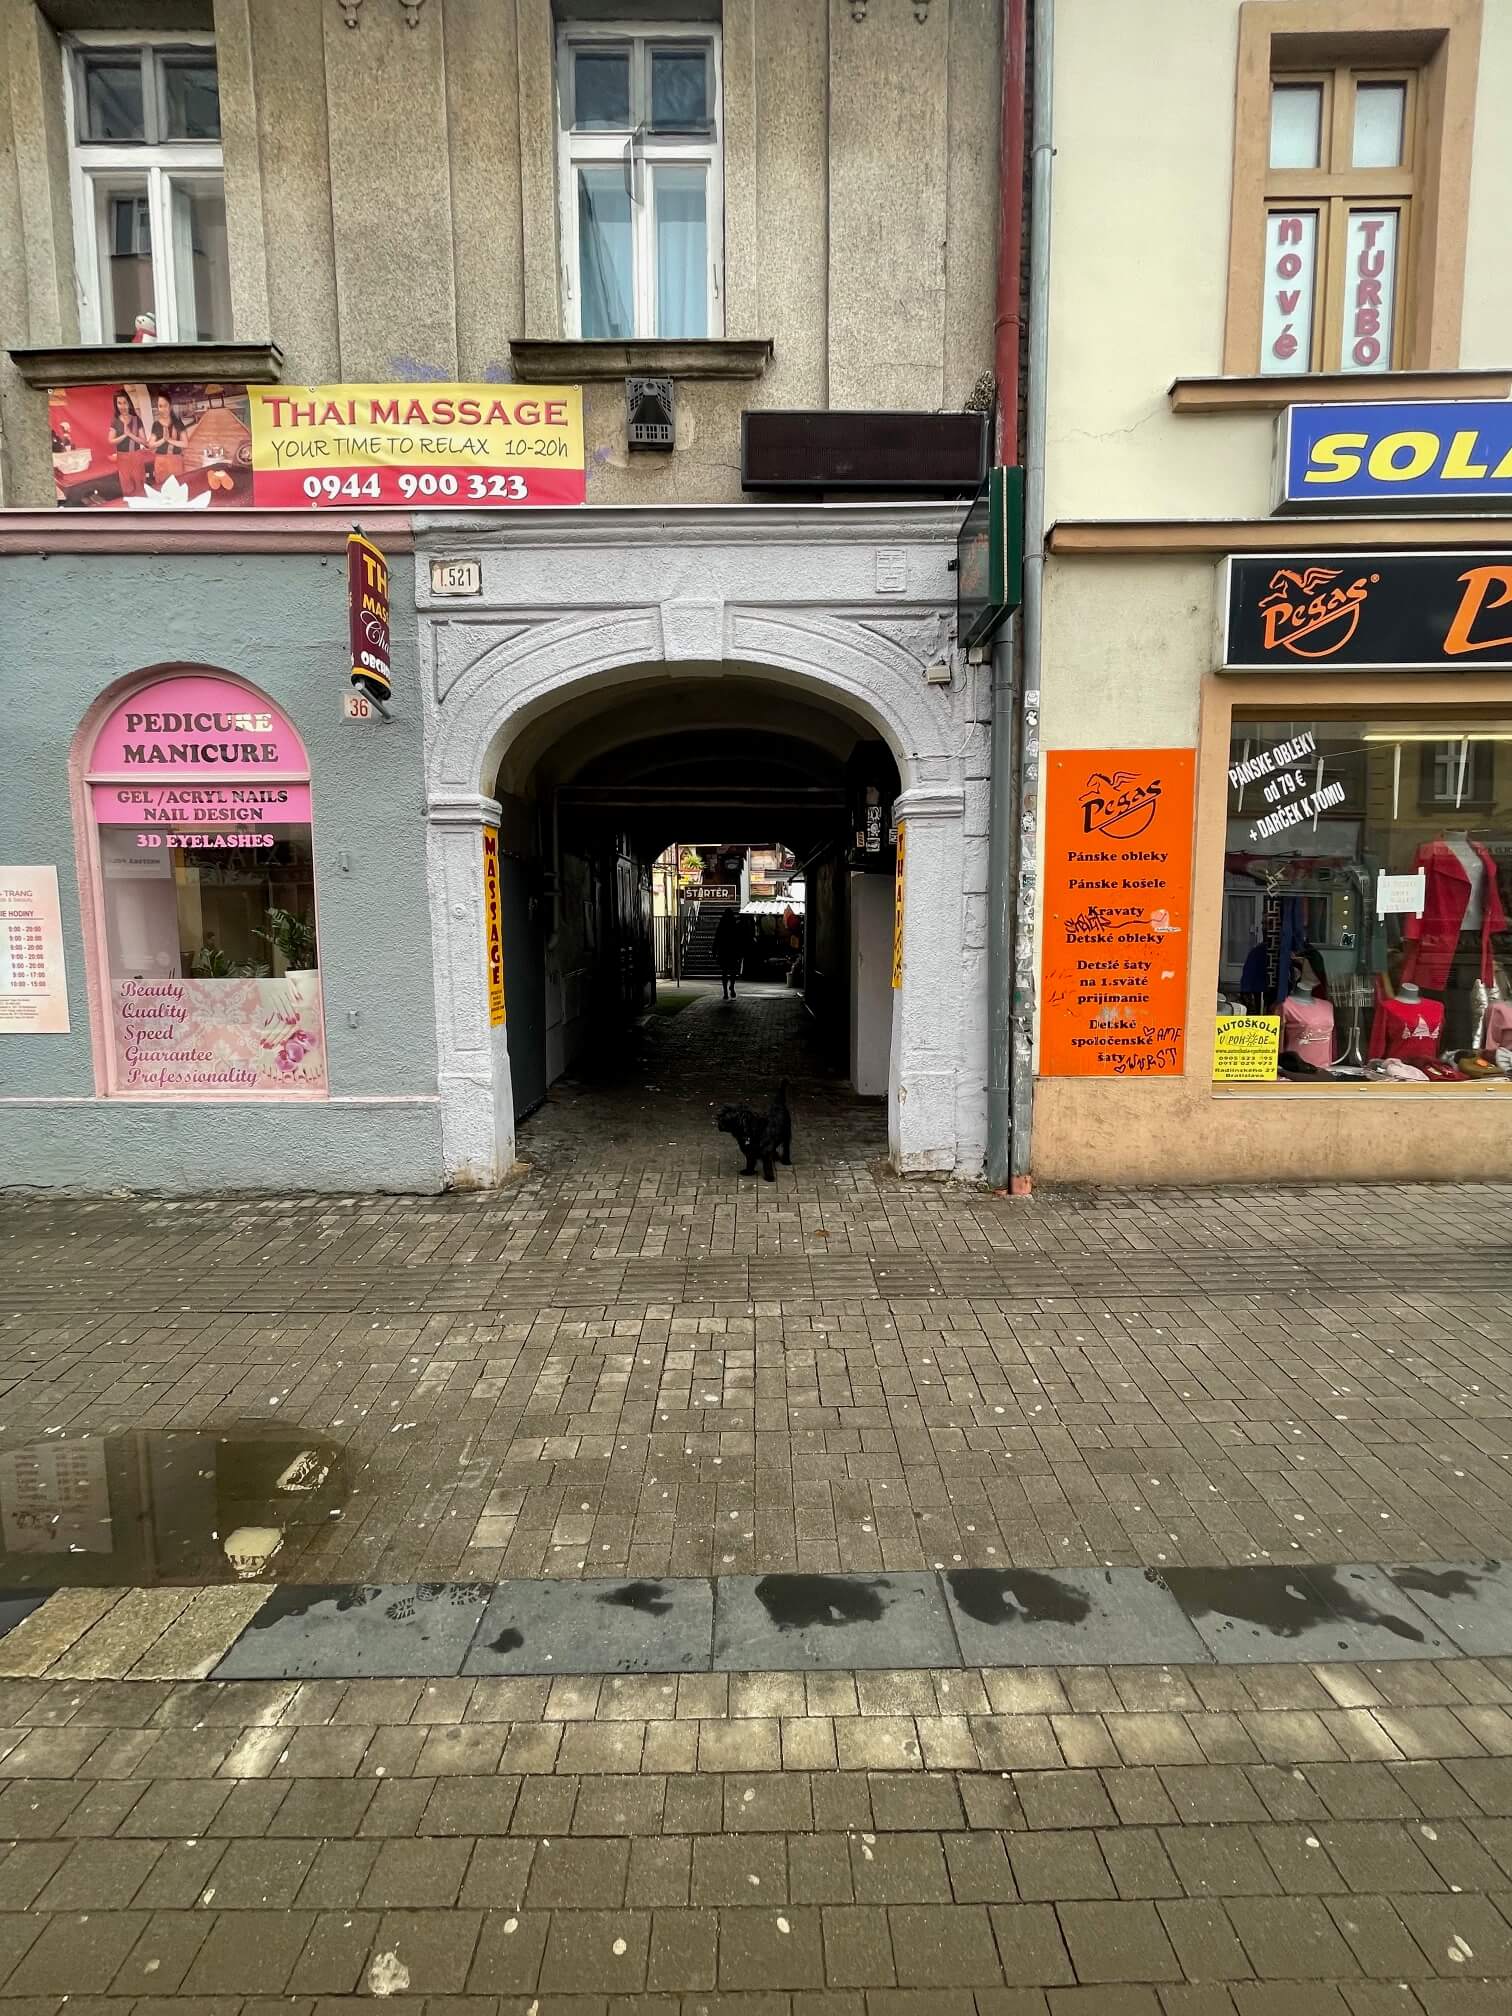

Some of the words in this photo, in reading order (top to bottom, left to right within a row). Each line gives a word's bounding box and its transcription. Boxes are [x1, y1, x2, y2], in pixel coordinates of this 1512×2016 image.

[1272, 217, 1303, 361] nové
[1352, 220, 1386, 366] TURBO
[262, 395, 356, 428] THAI
[370, 398, 569, 427] MASSAGE
[272, 438, 330, 467] YOUR
[335, 436, 381, 456] TIME
[387, 436, 413, 455] TO
[420, 436, 490, 457] RELAX
[505, 436, 569, 457] 10-20h
[303, 472, 381, 499] 0944
[398, 472, 458, 499] 900
[467, 474, 528, 499] 323
[350, 698, 369, 717] 36
[125, 712, 273, 733] PEDICURE
[123, 743, 279, 763] MANICURE
[1228, 751, 1276, 789] PÁNSKE
[1272, 731, 1316, 767] OBLEKY
[1263, 780, 1281, 803] od
[1277, 773, 1296, 796] 79
[1295, 769, 1307, 787] €
[117, 791, 153, 804] GEL
[232, 790, 288, 804] NAILS
[144, 808, 189, 821] NAIL
[194, 808, 263, 821] DESIGN
[1256, 802, 1304, 839] DARČEK
[1300, 797, 1314, 818] K
[1309, 781, 1346, 813] TOMU
[137, 834, 162, 848] 3D
[166, 834, 274, 848] EYELASHES
[1068, 851, 1118, 861] Pánske
[1121, 851, 1168, 863] obleky
[896, 832, 904, 928] THAI
[1069, 878, 1118, 889] Pánske
[1122, 878, 1166, 889] košele
[5, 889, 33, 898] TRANG
[8, 910, 35, 918] HODINY
[485, 835, 500, 986] MASSAGE
[1088, 905, 1145, 918] Kravaty
[1066, 933, 1114, 944] Detské
[1118, 933, 1165, 945] obleky
[1123, 960, 1152, 971] šaty
[120, 981, 185, 1001] Beauty
[1080, 977, 1097, 987] na
[1078, 993, 1150, 1005] prijímanie
[122, 1002, 187, 1023] Quality
[124, 1024, 174, 1045] Speed
[1217, 1018, 1277, 1036] AUTOŠKOLA
[1071, 1035, 1153, 1048] spoločenské
[125, 1046, 213, 1066] Guarantee
[1097, 1052, 1125, 1064] šaty
[127, 1067, 257, 1088] Professionality
